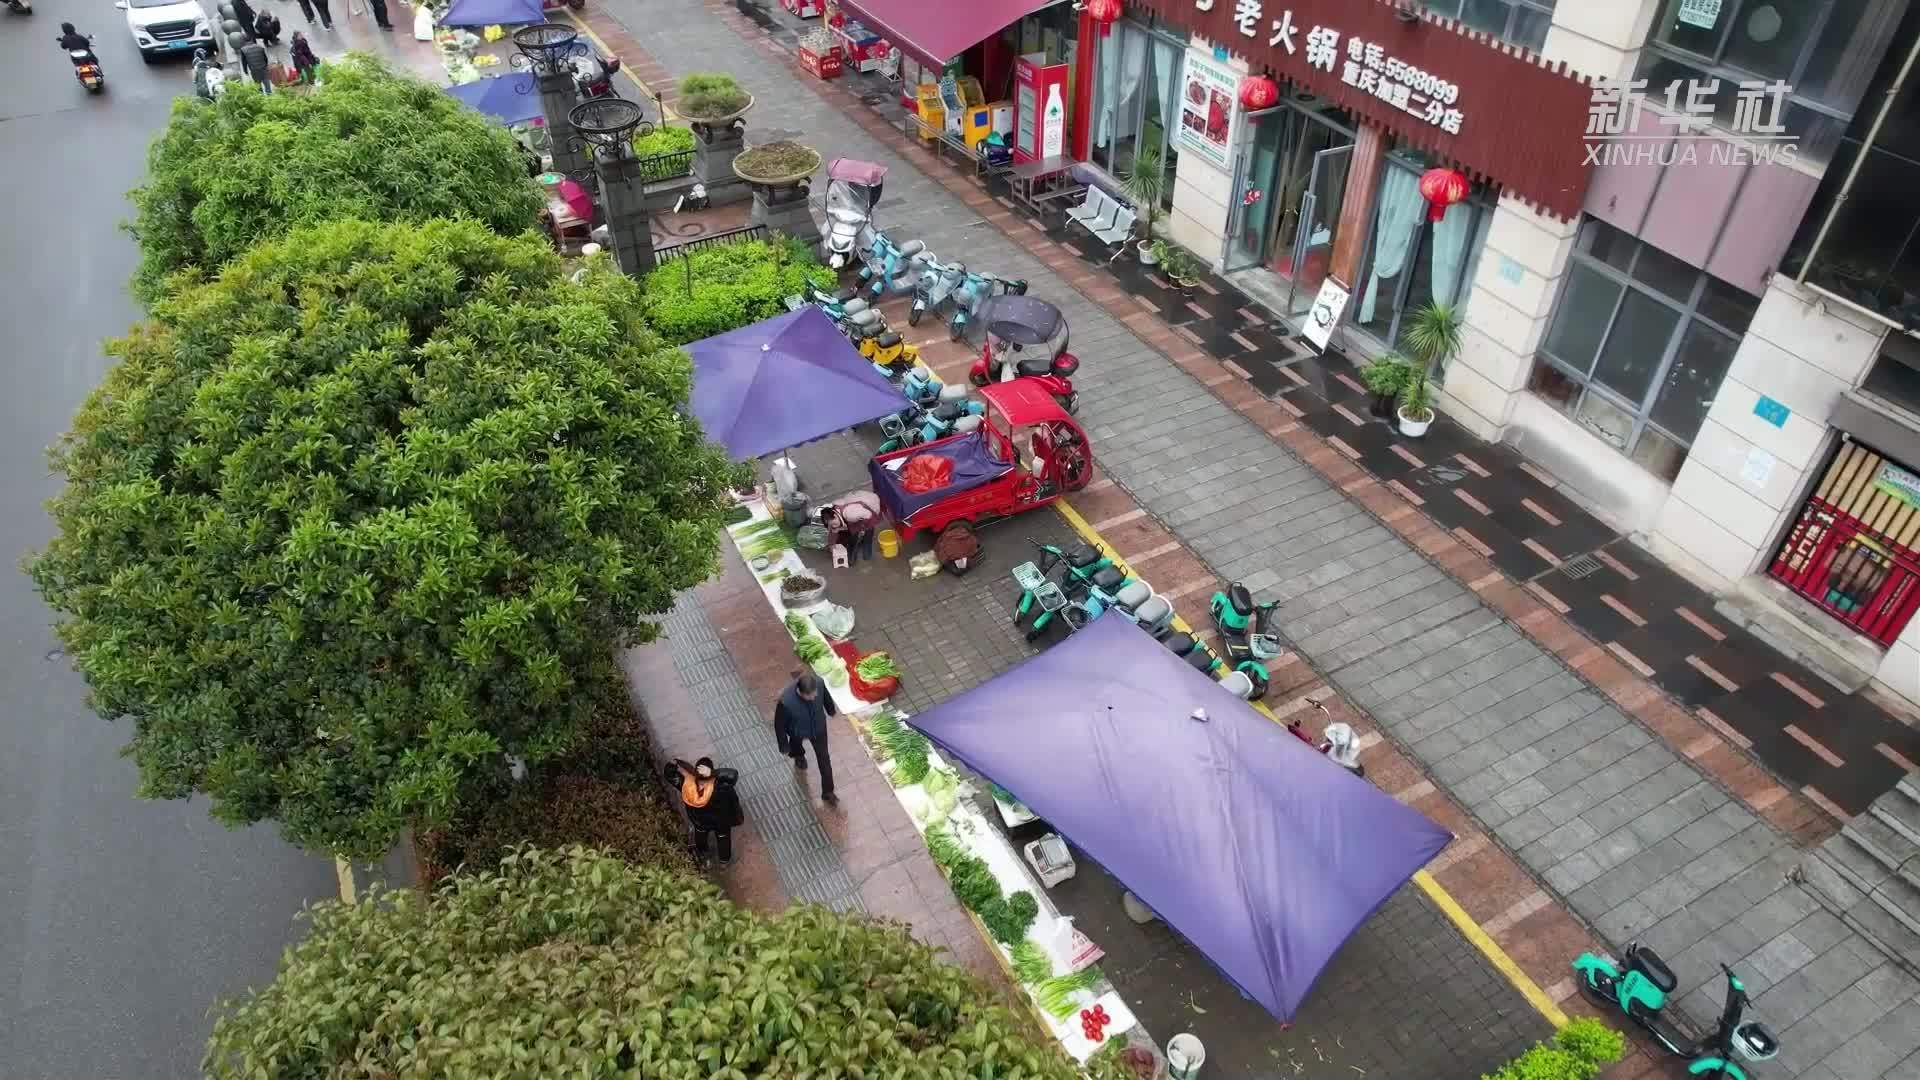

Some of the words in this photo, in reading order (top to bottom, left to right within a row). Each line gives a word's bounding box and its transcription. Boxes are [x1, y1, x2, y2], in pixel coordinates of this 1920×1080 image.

[1196, 0, 1341, 73] 老火锅
[1347, 36, 1459, 104] 电话:5588099
[1341, 60, 1464, 135] 重庆加盟二分店
